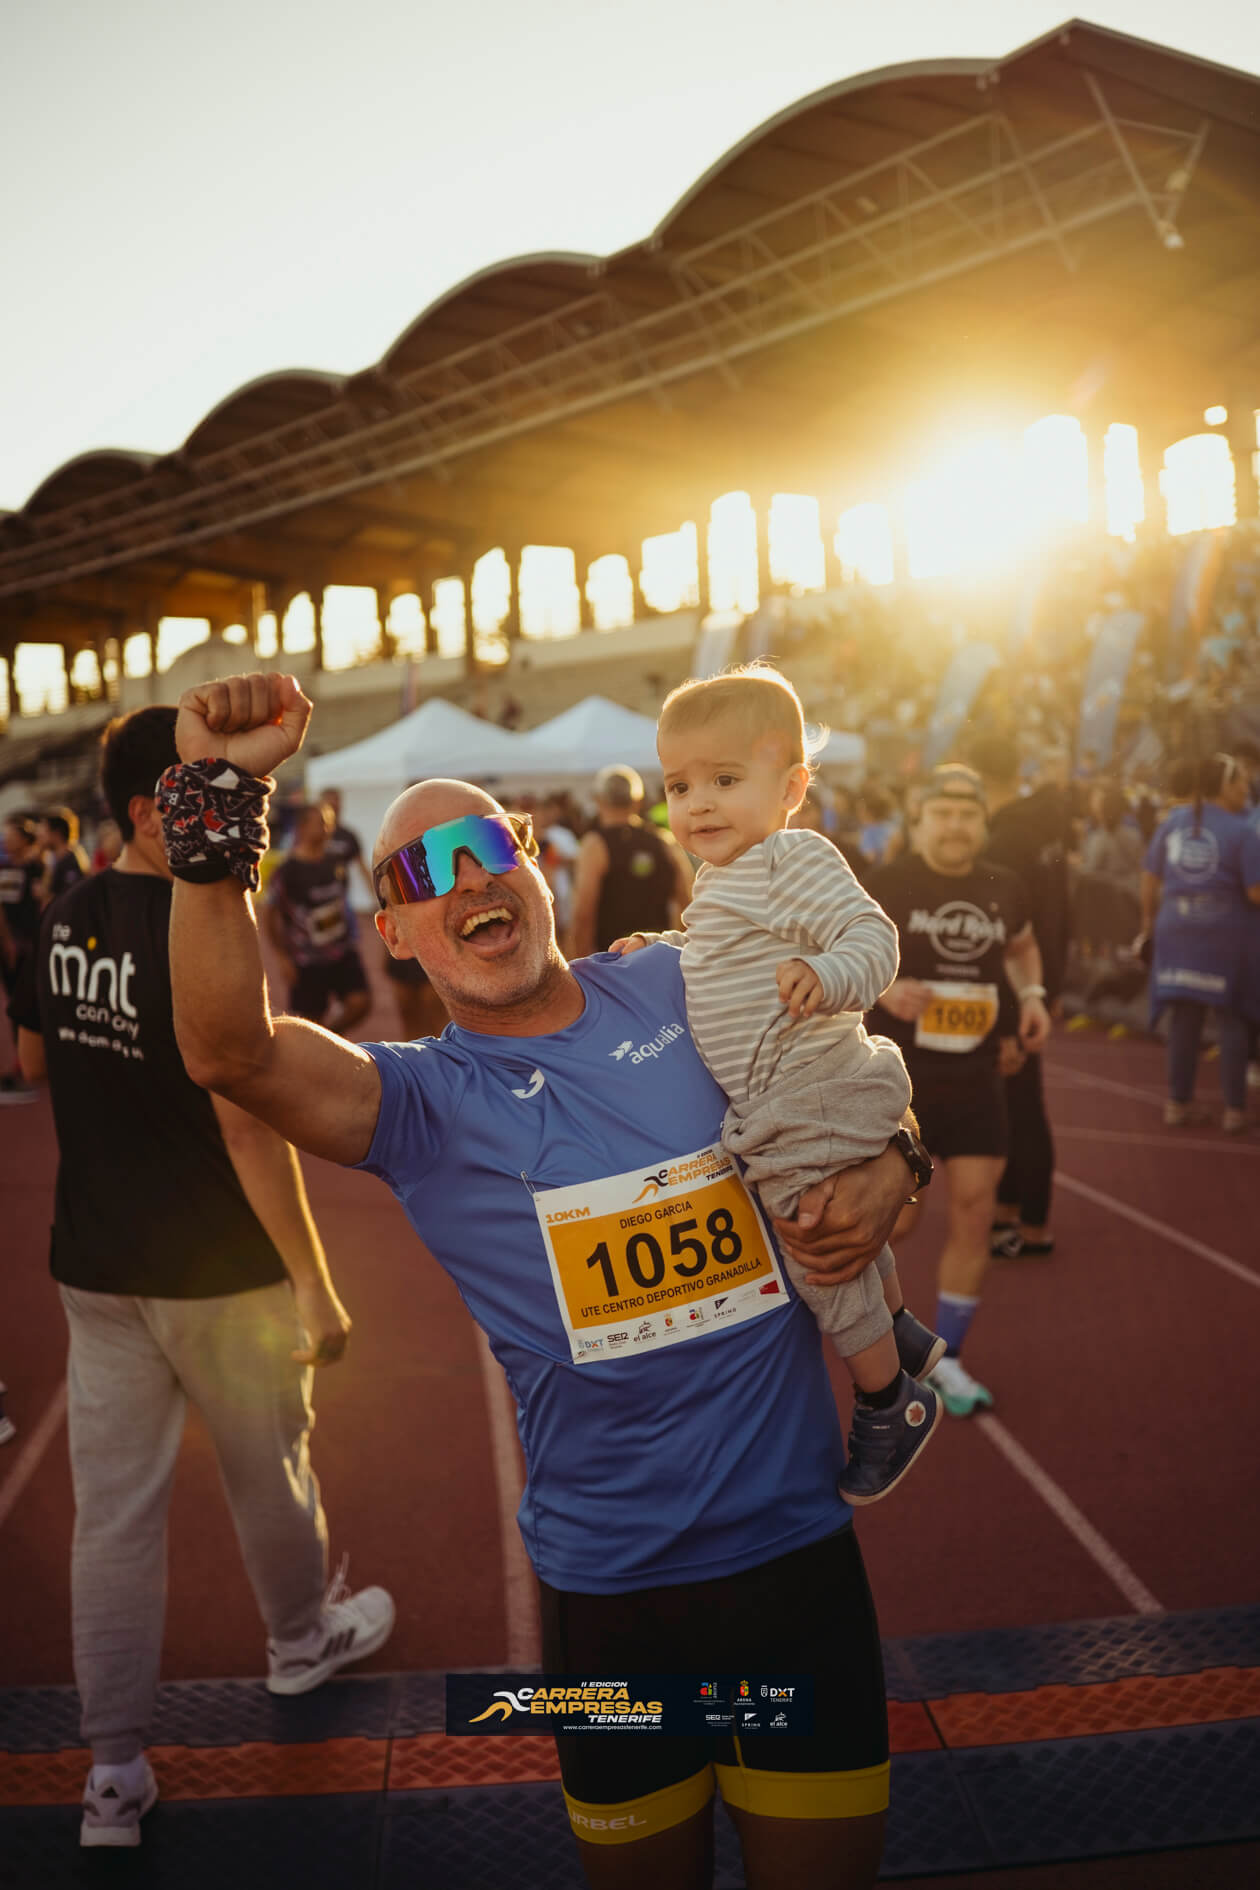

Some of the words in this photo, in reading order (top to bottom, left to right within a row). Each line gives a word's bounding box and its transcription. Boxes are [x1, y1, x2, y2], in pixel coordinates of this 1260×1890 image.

[628, 1023, 685, 1064] aqualia
[545, 1206, 591, 1224] 10KM
[619, 1212, 653, 1230] DIEGO
[654, 1200, 693, 1220] GARCIA
[586, 1207, 743, 1298] 1058
[581, 1305, 601, 1318] UTE
[602, 1296, 645, 1314] CENTRO
[647, 1280, 704, 1304] DEPORTIVO
[706, 1257, 762, 1287] GRANADILLA
